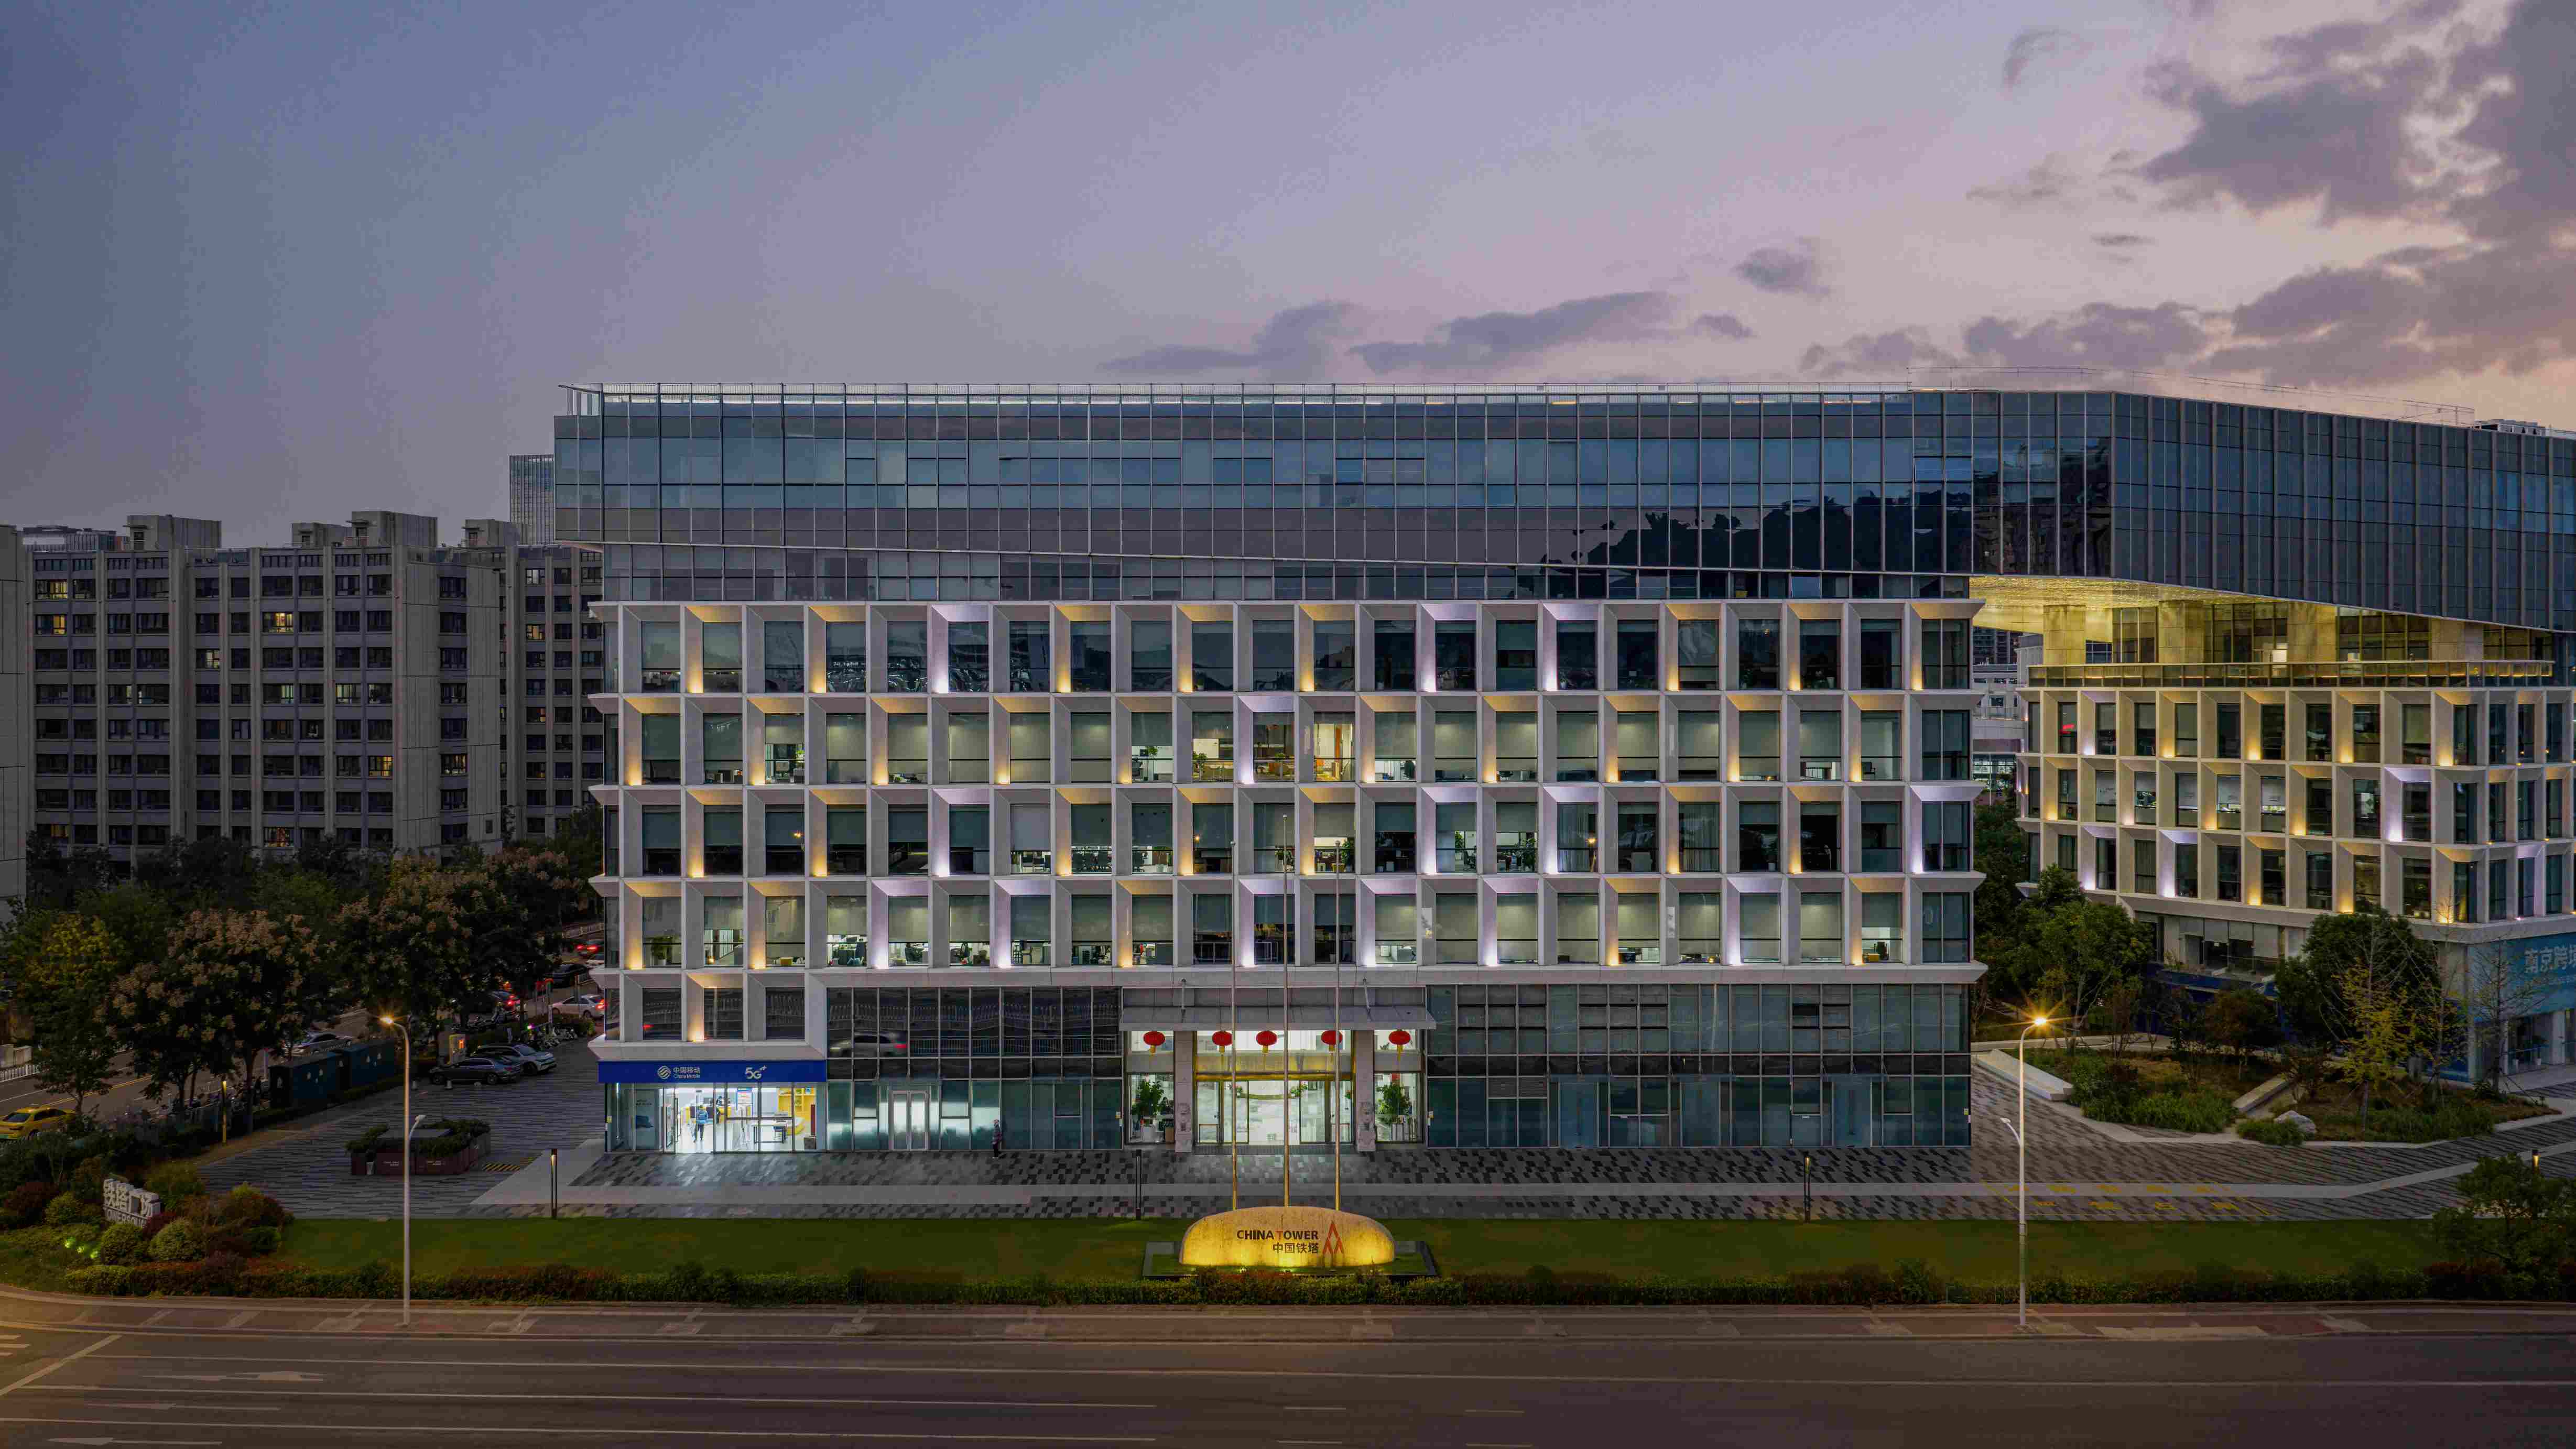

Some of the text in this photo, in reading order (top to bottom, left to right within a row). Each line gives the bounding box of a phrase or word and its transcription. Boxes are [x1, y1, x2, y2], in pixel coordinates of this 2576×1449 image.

[1237, 1229, 1319, 1240] CHINA TOWER
[1273, 1242, 1319, 1254] 中国铁塔
